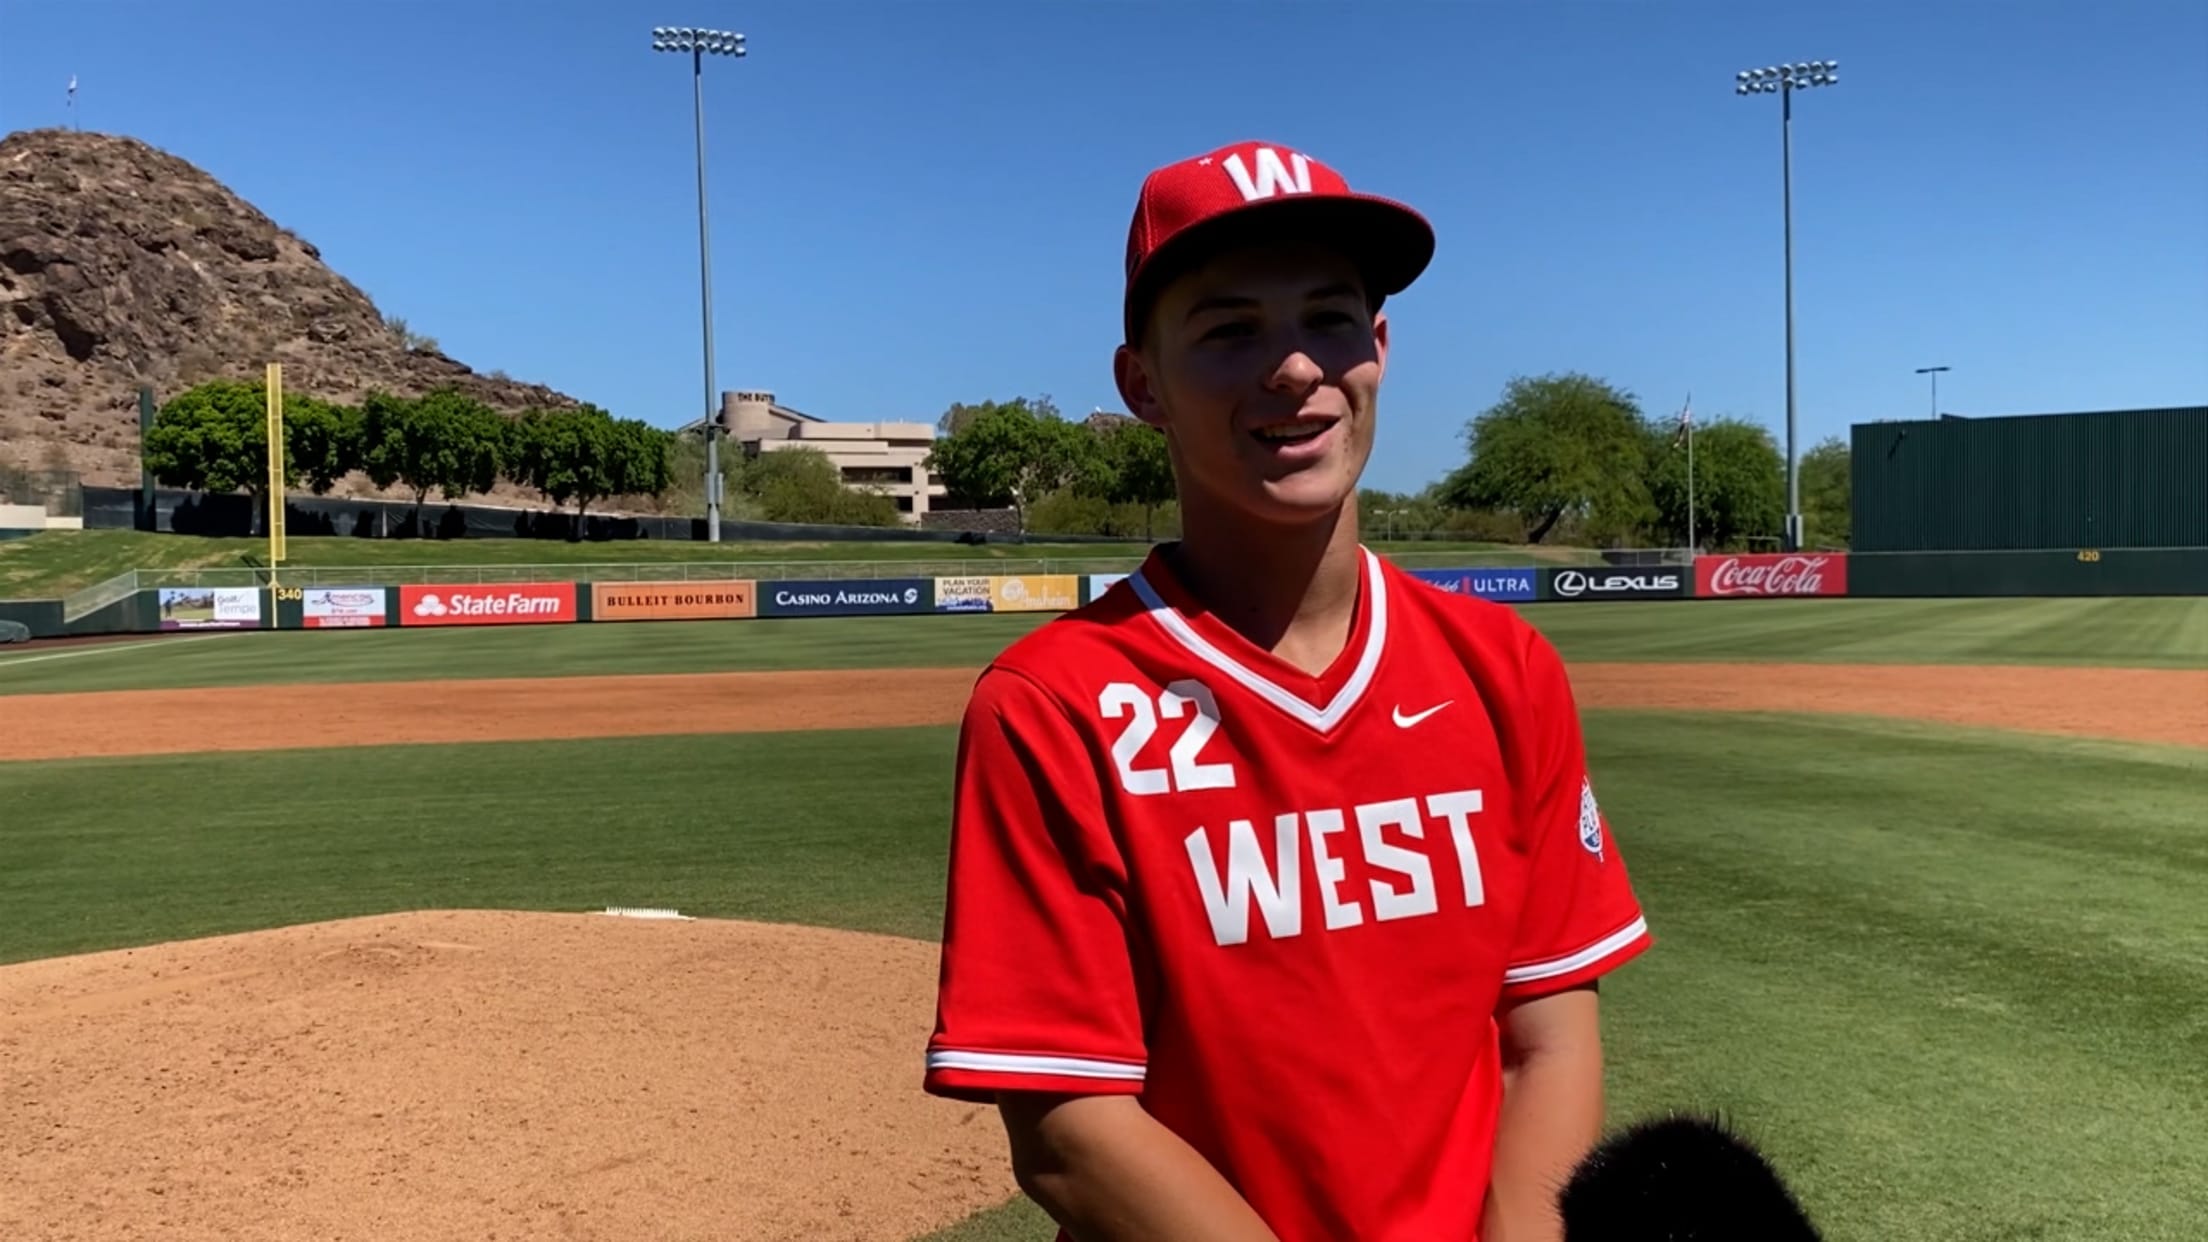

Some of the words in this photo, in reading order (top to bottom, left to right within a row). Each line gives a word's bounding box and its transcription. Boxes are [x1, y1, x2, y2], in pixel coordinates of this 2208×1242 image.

[1221, 147, 1312, 202] W
[2077, 551, 2100, 562] 420
[943, 579, 965, 587] PLAN
[967, 578, 990, 586] YOUR
[1588, 575, 1679, 591] LEXUS
[1710, 557, 1829, 595] Coca-Cola
[943, 586, 991, 595] VACATION
[1473, 578, 1531, 593] ULTRA
[277, 588, 302, 601] 340
[607, 594, 669, 607] BULLEIT
[675, 593, 744, 606] BOURBON
[1099, 679, 1237, 796] 22
[1184, 789, 1485, 947] WEST
